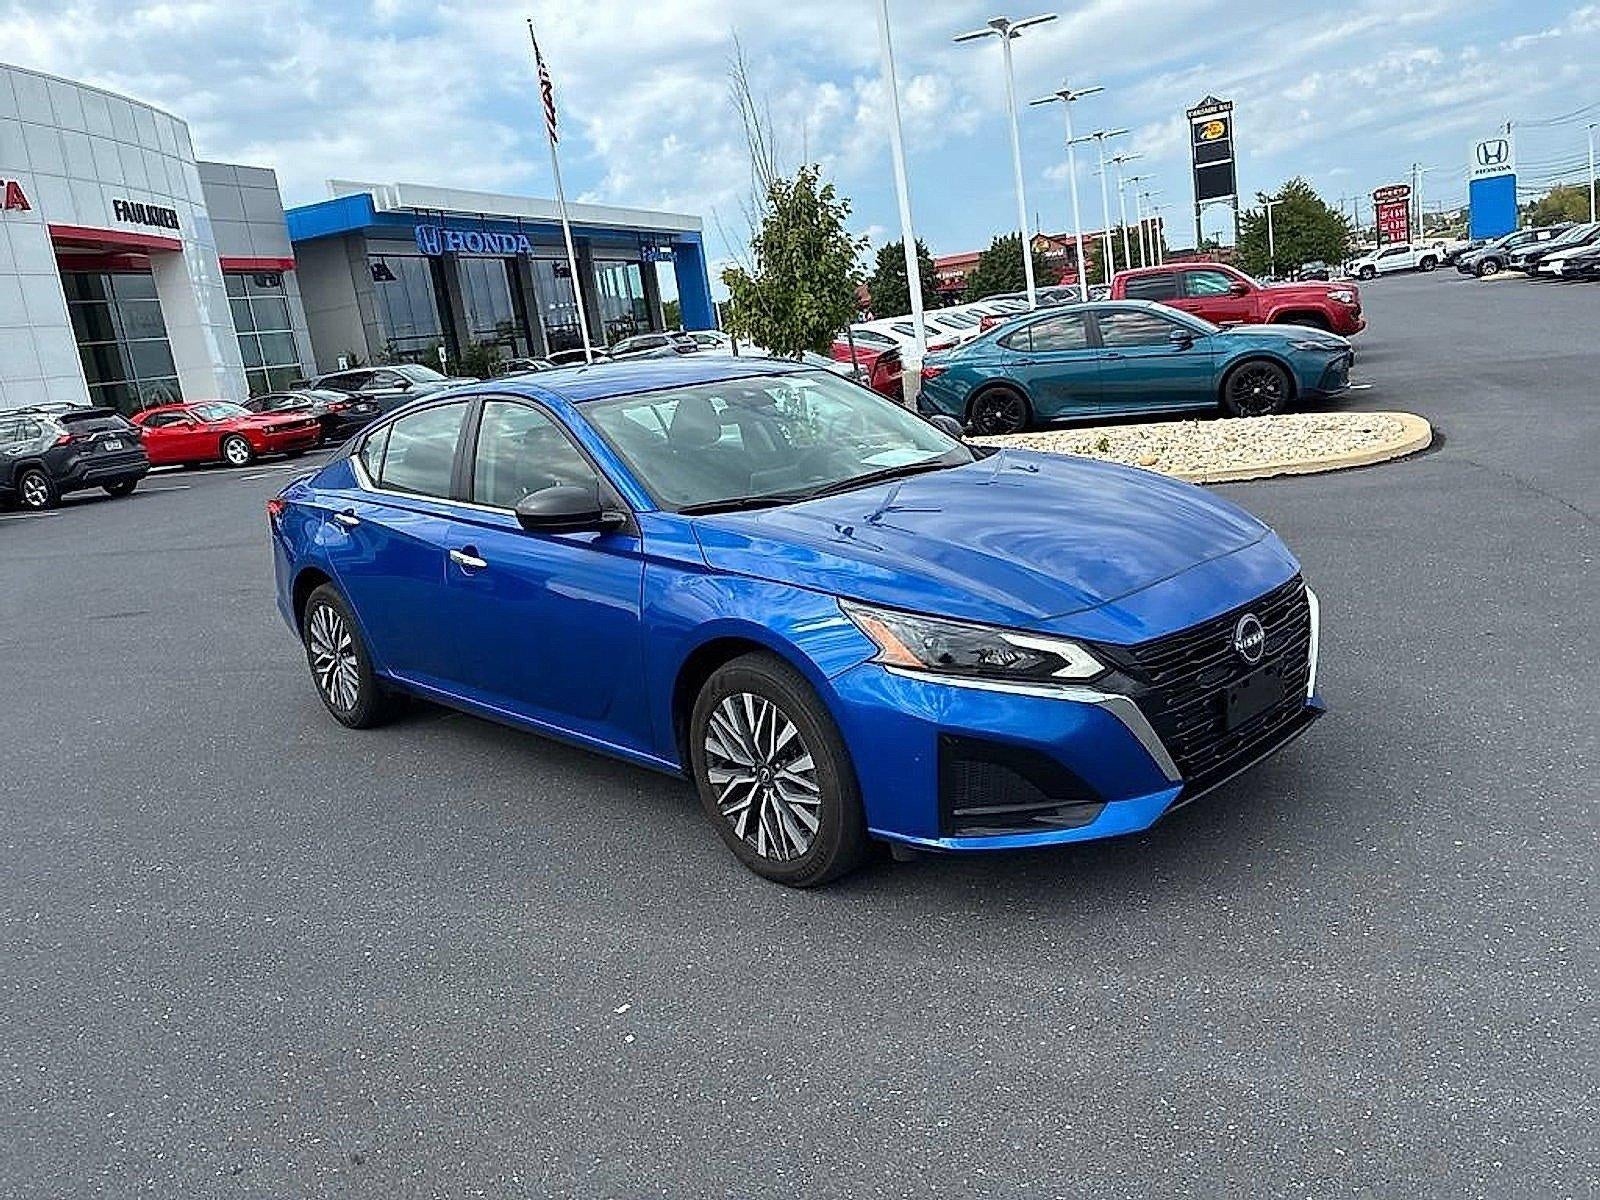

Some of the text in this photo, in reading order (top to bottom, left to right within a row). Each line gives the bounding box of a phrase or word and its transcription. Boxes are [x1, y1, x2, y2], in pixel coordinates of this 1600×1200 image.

[1475, 164, 1512, 175] HONDA
[112, 199, 180, 230] FAULKNER
[441, 230, 532, 254] HONDA
